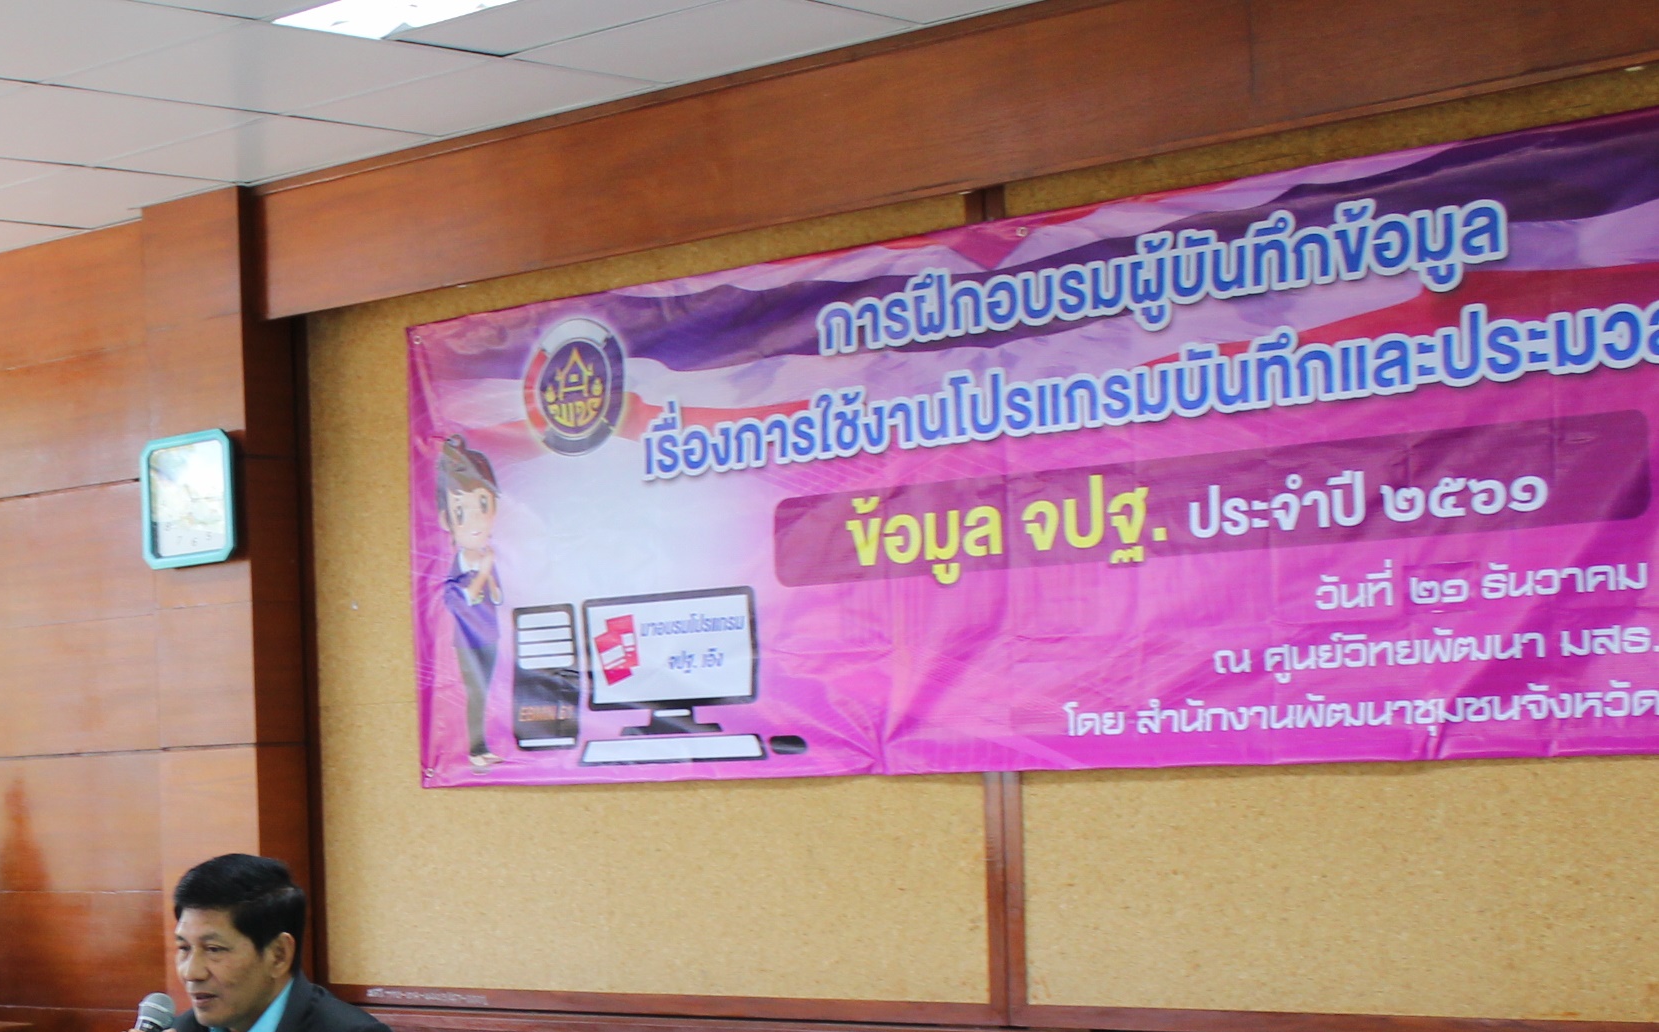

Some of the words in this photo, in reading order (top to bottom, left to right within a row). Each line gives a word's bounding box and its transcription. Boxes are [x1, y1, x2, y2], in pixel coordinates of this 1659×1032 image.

[819, 199, 1506, 354] การฝึกอบรมผู้บันทึกข้อมูล
[846, 494, 1002, 585] ข้อมูล
[1022, 473, 1167, 565] จปฐ.
[1188, 470, 1366, 538] ประจำปี
[1379, 474, 1549, 522] ๒๕๖๑
[1314, 558, 1394, 610] วันที่
[1408, 576, 1470, 605] ๒๑
[1481, 561, 1649, 600] ธันวาคม
[1213, 647, 1251, 674] ณ
[1263, 626, 1545, 684] ศูนย์วิทยพัฒนา
[1062, 701, 1125, 738] โดย
[1135, 680, 1659, 738] สำนักงานพัฒนาชุมชนจังหวัด
